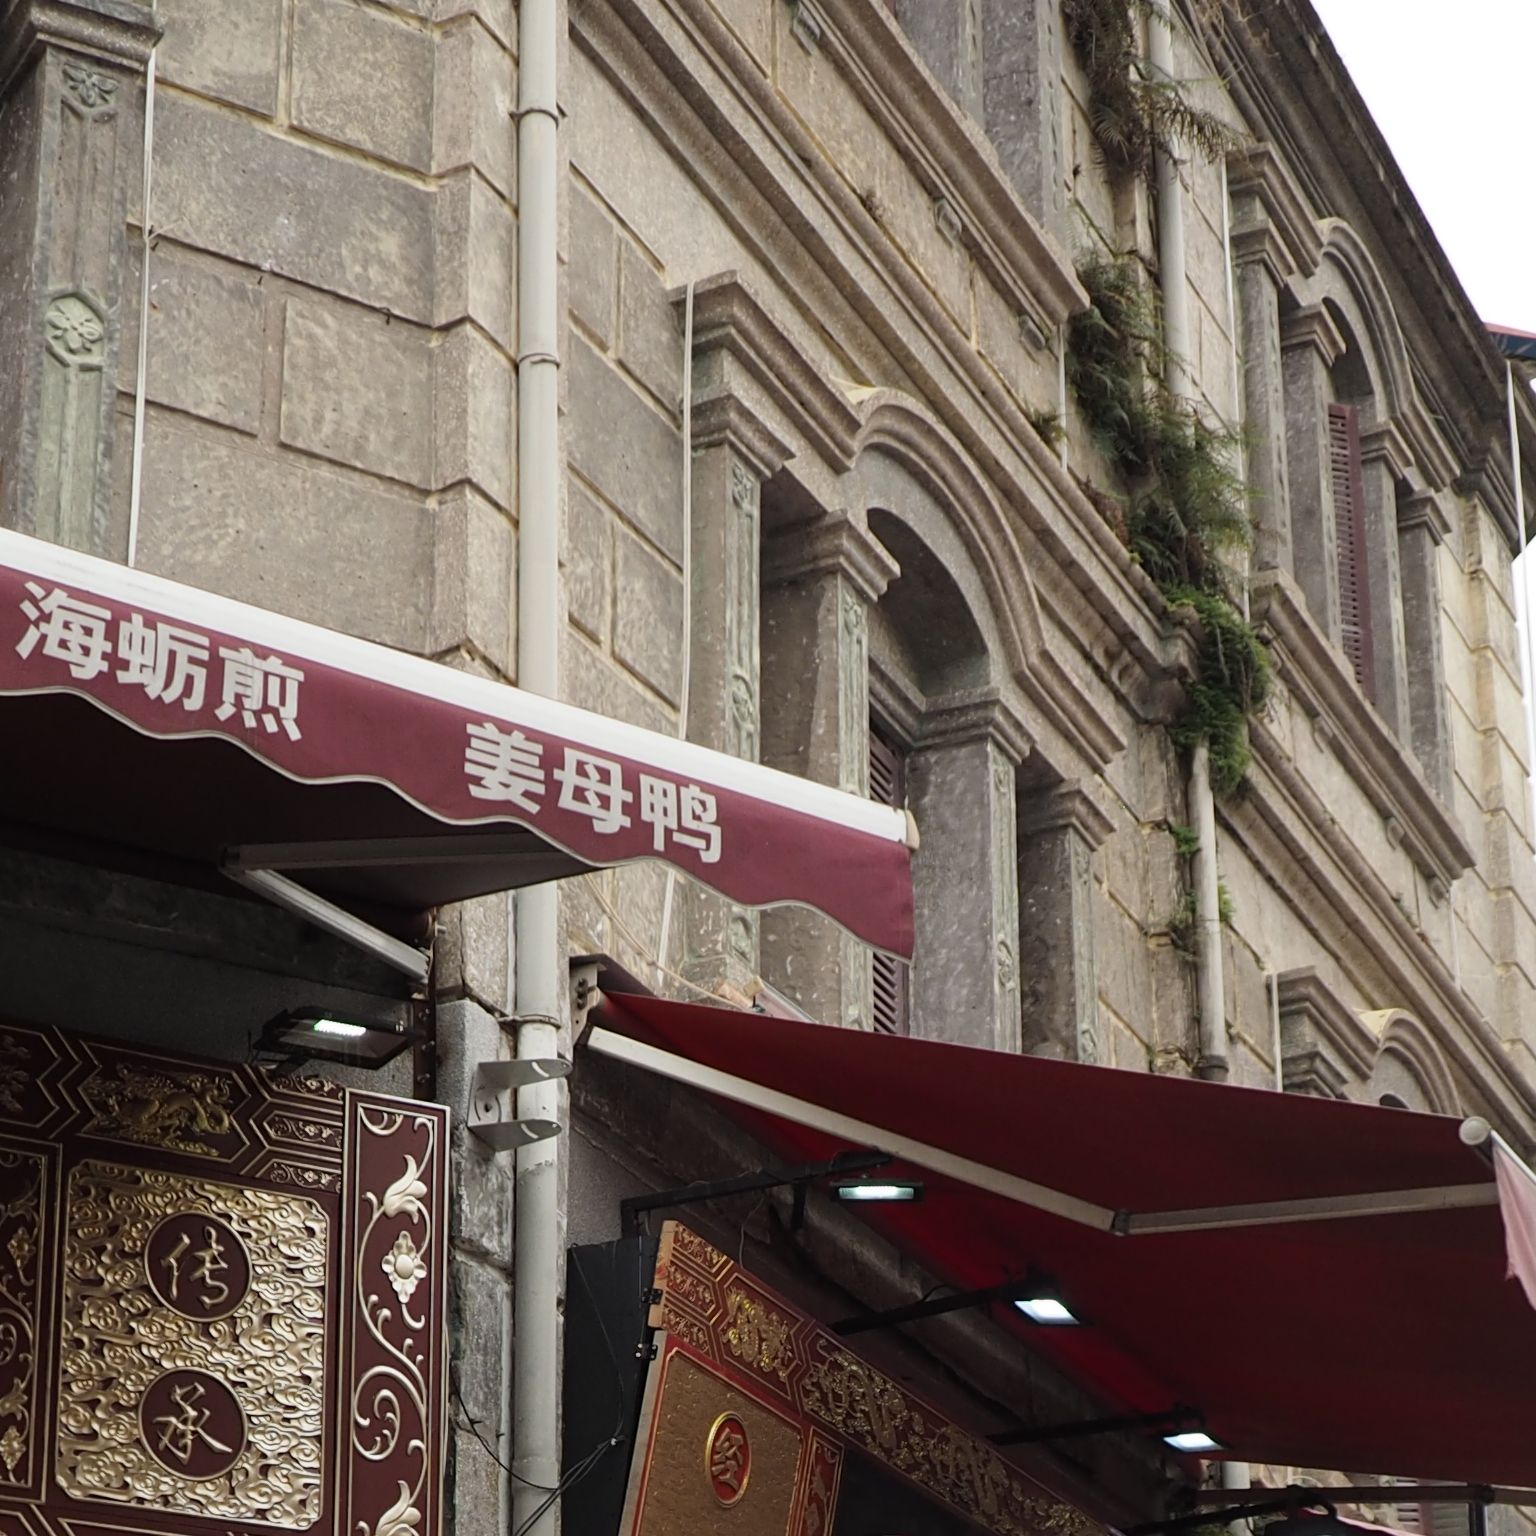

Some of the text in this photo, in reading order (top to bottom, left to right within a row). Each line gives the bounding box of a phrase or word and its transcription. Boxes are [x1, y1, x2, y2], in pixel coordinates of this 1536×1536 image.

[15, 580, 305, 741] 海蛎煎
[464, 722, 724, 864] 姜母鸭
[158, 1225, 233, 1464] 传承
